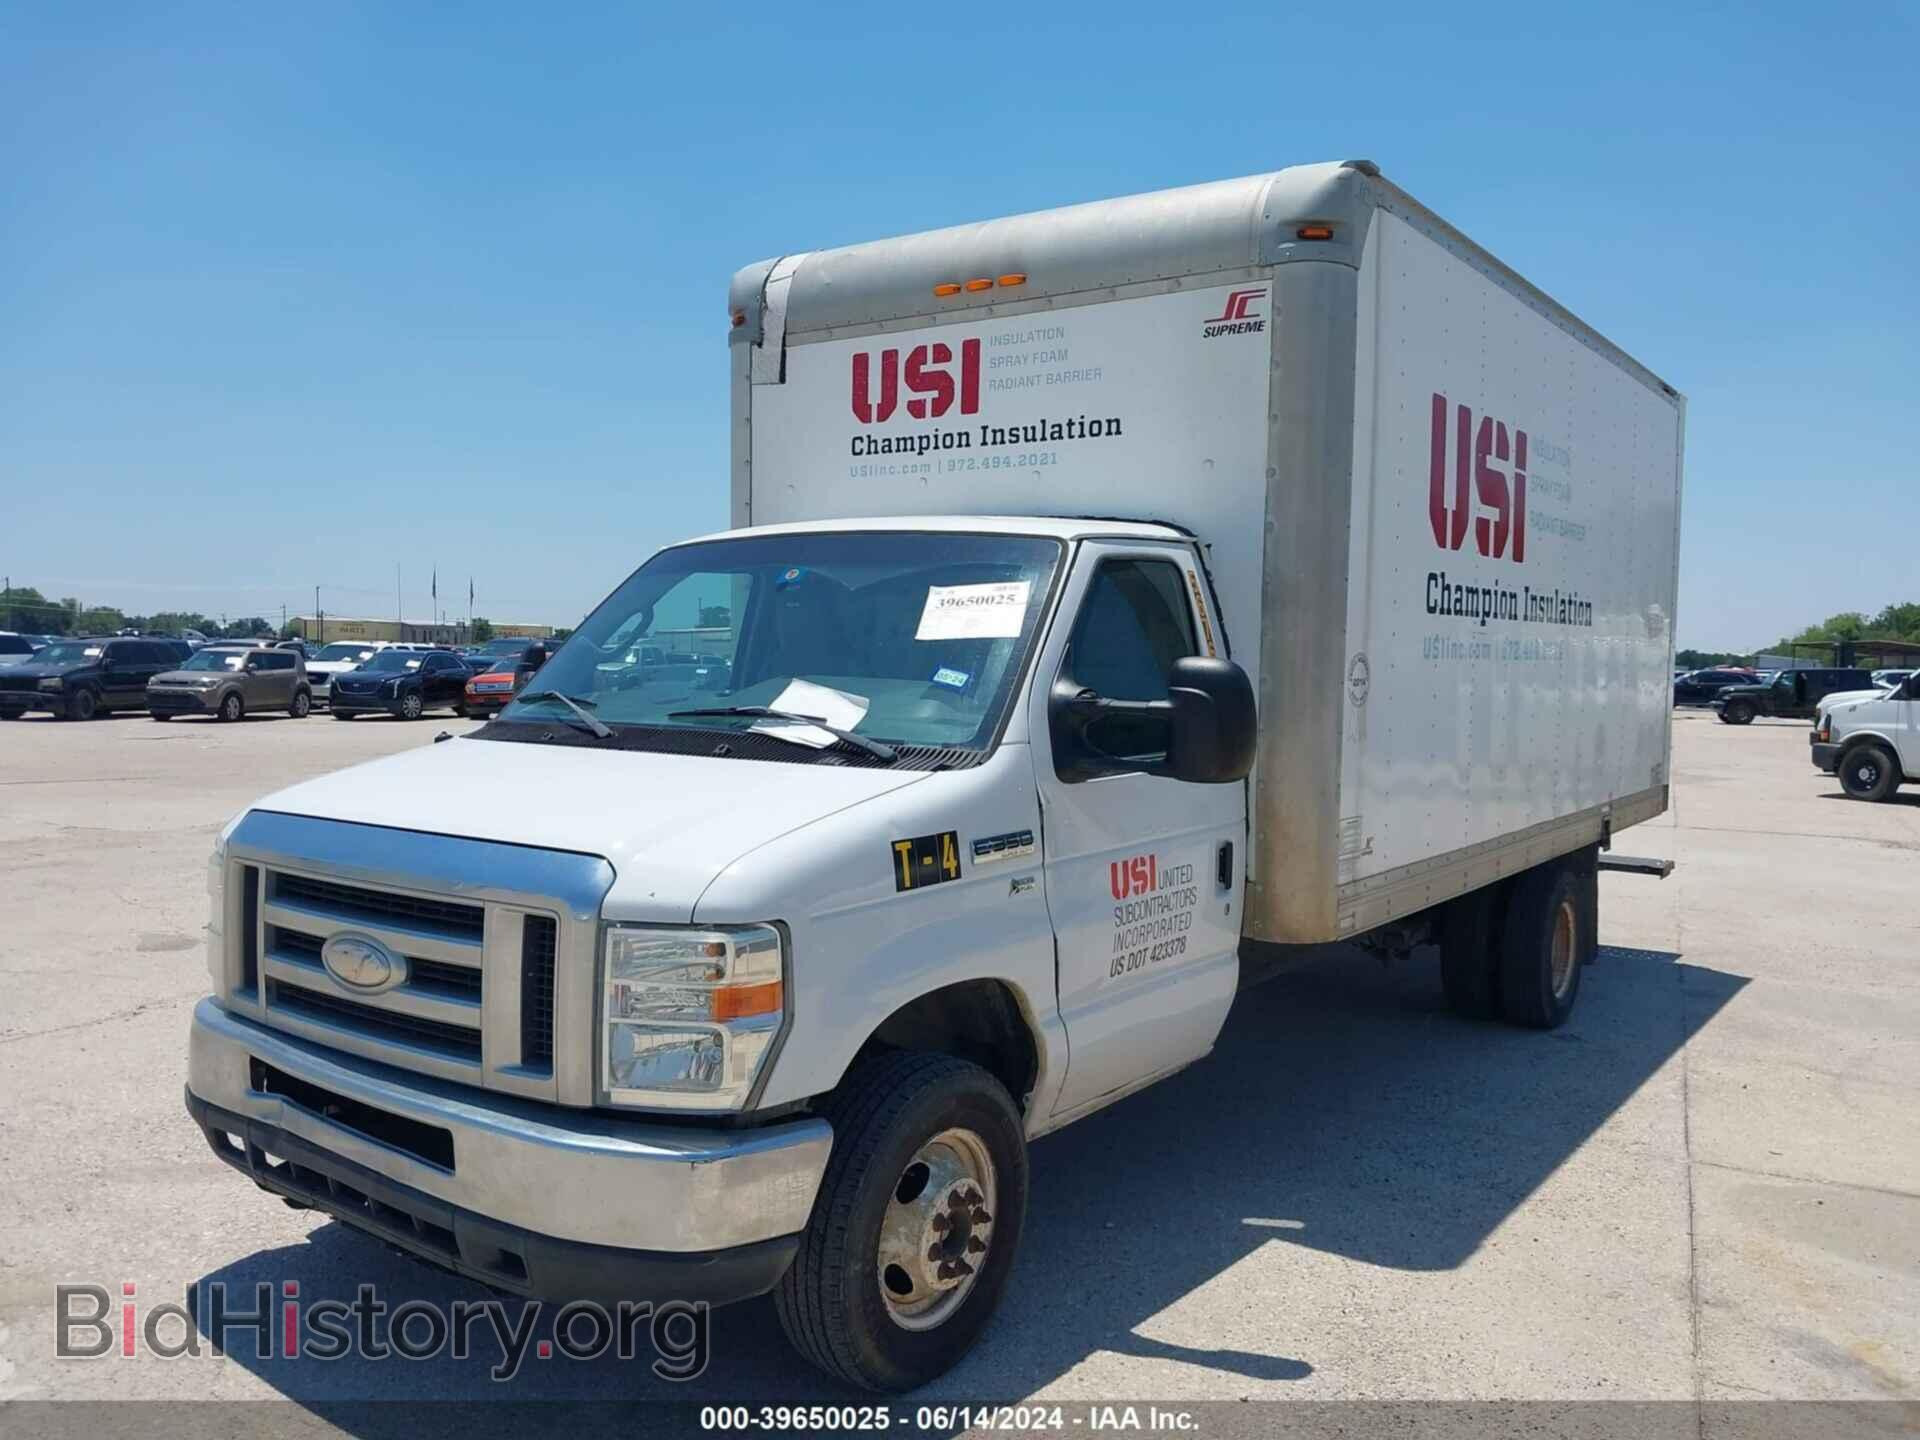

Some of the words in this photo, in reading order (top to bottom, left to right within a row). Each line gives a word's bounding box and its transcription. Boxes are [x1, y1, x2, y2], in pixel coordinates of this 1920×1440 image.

[990, 328, 1065, 346] INSULATION
[1203, 320, 1266, 338] SUPREME
[989, 354, 1029, 369] SPRAY
[1032, 349, 1069, 364] FOAM
[852, 338, 980, 424] USI
[989, 375, 1041, 392] RADIANT
[1046, 368, 1102, 384] BARRIER
[851, 428, 971, 456] Champion
[980, 415, 1122, 447] Insulation
[1429, 392, 1527, 563] USI
[937, 594, 1016, 609] 39650025
[1426, 572, 1518, 626] Champion
[1523, 586, 1592, 627] Insulation
[895, 834, 958, 888] T-4
[1110, 854, 1156, 900] USI
[1158, 863, 1193, 890] UNITED
[1113, 886, 1198, 928] SUBCONTRACTORS
[1113, 911, 1193, 953] INCORPORATED
[1110, 956, 1125, 978] US
[1127, 946, 1149, 972] DOT
